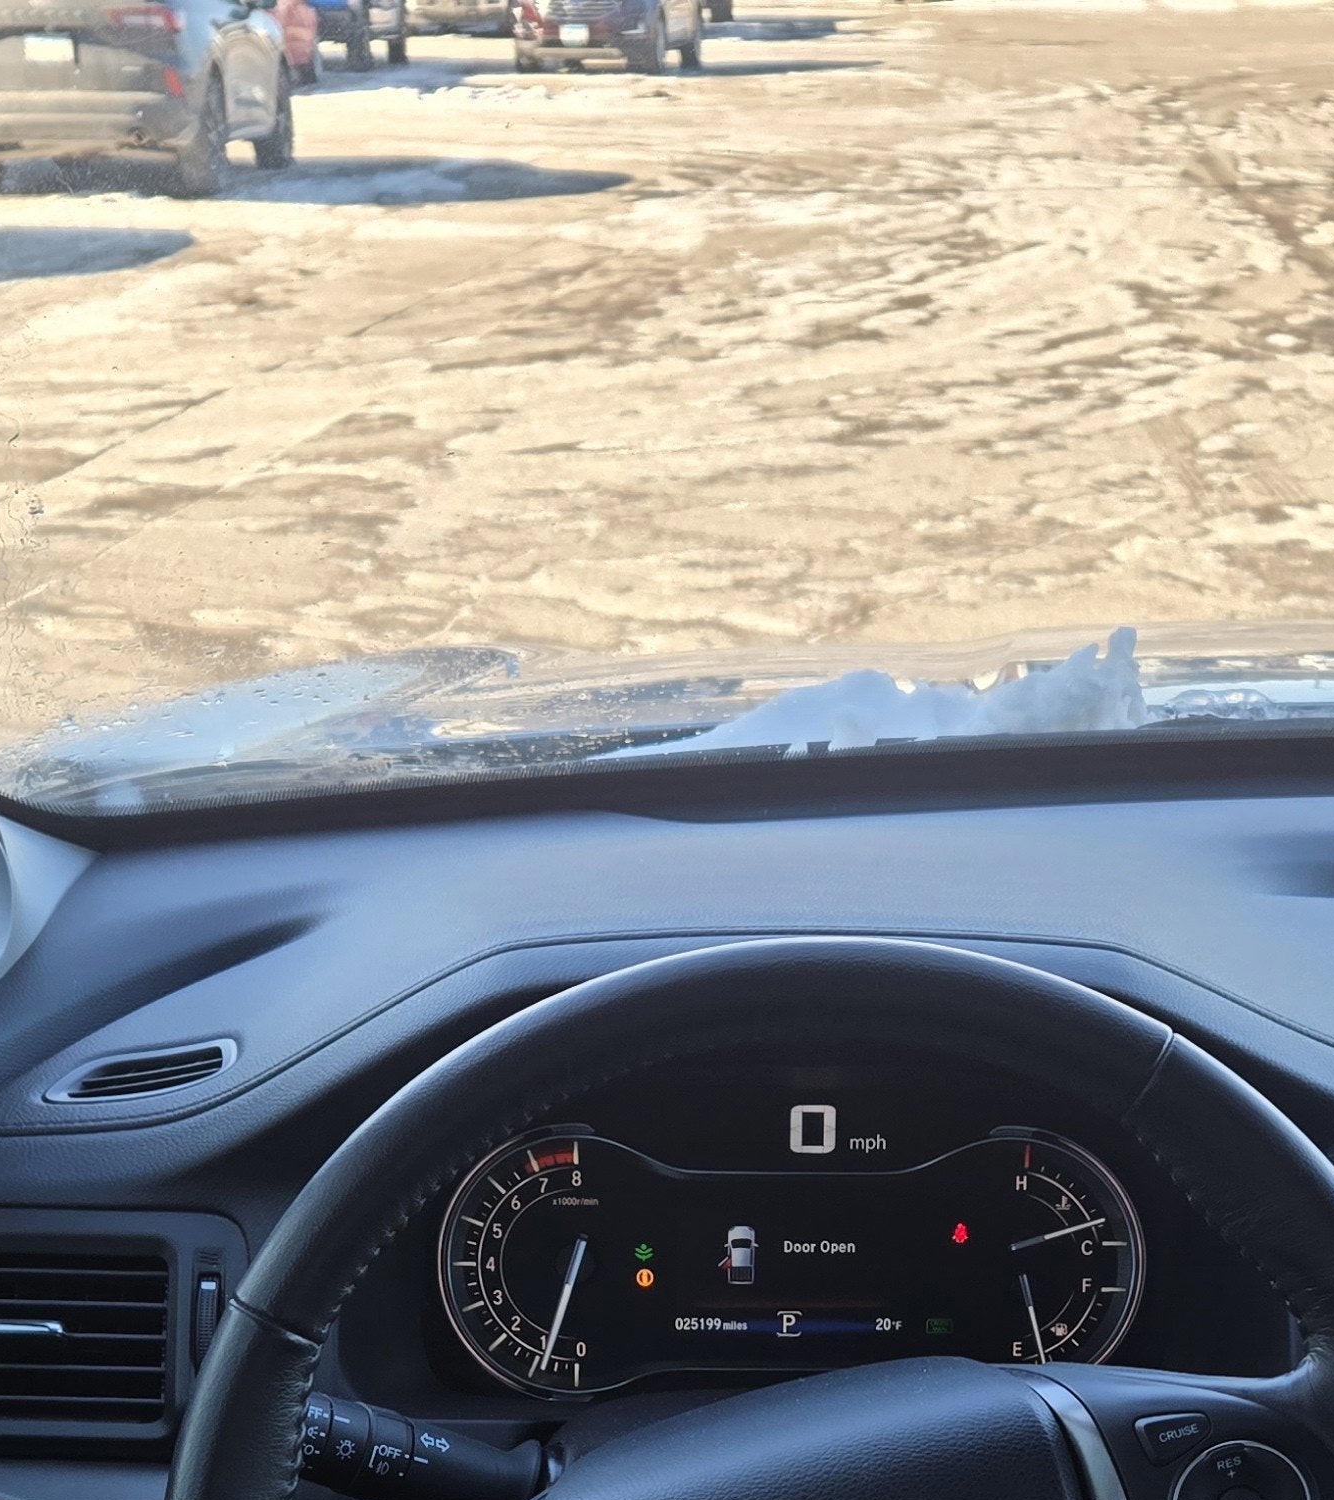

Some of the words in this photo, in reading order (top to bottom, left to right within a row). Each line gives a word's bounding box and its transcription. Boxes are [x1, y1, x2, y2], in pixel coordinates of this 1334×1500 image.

[790, 1104, 837, 1154] 0
[849, 1133, 887, 1154] mph
[538, 1177, 549, 1194] 7
[571, 1170, 582, 1187] 8
[1016, 1175, 1028, 1191] H
[511, 1194, 521, 1210] 6
[492, 1223, 503, 1239] 5
[783, 1240, 816, 1254] Door
[820, 1240, 856, 1255] Open
[1081, 1240, 1093, 1256] C
[485, 1256, 496, 1272] 4
[1081, 1278, 1092, 1293] F
[492, 1289, 503, 1306] 3
[510, 1315, 521, 1331] 2
[674, 1317, 722, 1331] 025199
[722, 1320, 748, 1331] miles
[782, 1314, 796, 1333] P
[540, 1335, 548, 1350] 1
[575, 1341, 587, 1357] 0
[1012, 1341, 1023, 1357] E
[307, 1404, 324, 1420] FF
[1158, 1423, 1200, 1443] CRUISE
[378, 1444, 403, 1460] OFF
[1216, 1455, 1242, 1471] RES
